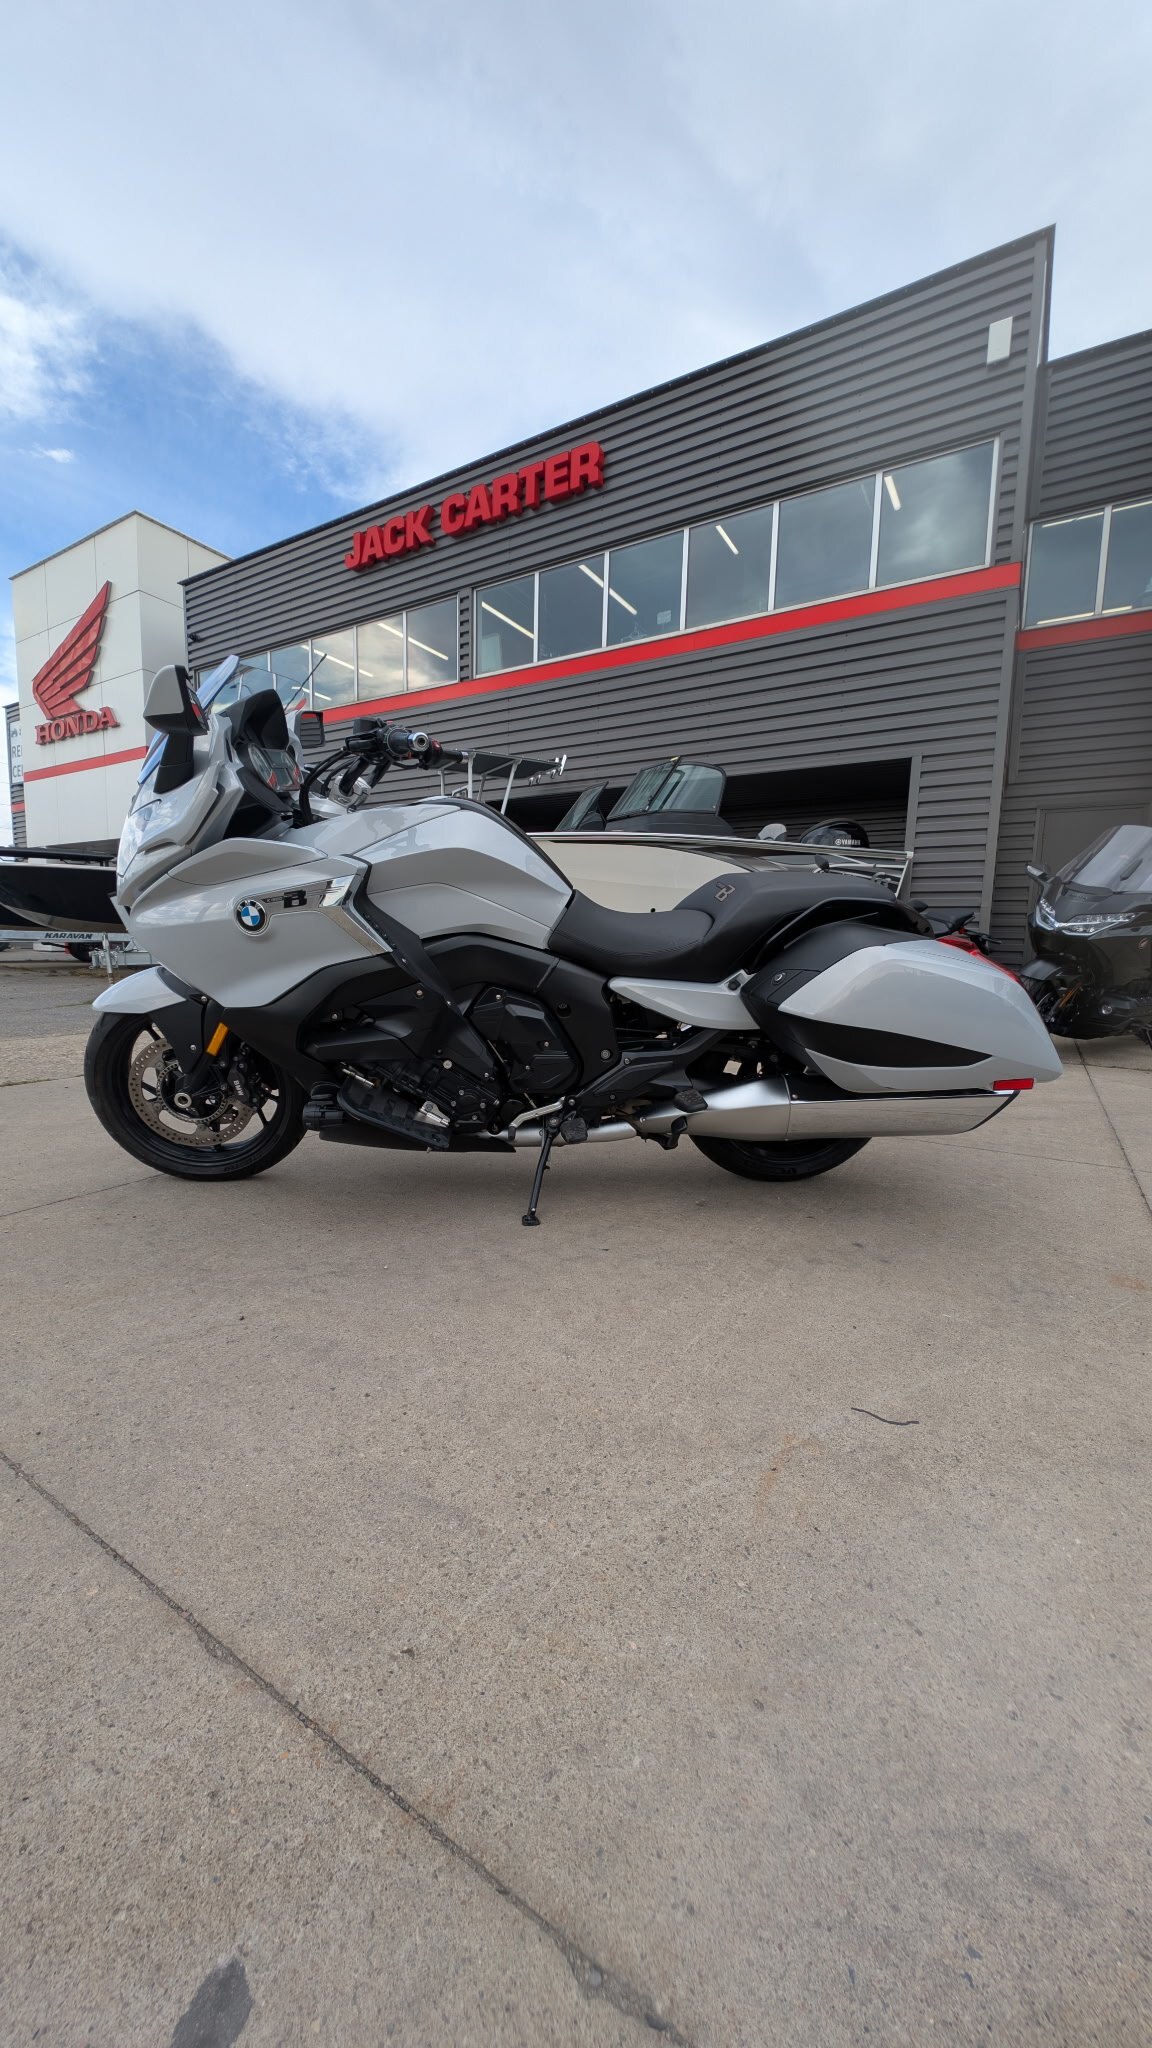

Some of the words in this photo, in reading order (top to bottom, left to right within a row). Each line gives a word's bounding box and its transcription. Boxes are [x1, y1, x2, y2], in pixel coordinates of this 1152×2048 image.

[344, 504, 436, 572] JACK
[440, 441, 605, 538] CARTER
[35, 706, 119, 746] HONDA
[11, 744, 22, 758] RE
[12, 764, 23, 778] CE
[45, 932, 93, 940] KARAVAN
[233, 1080, 244, 1095] BMW
